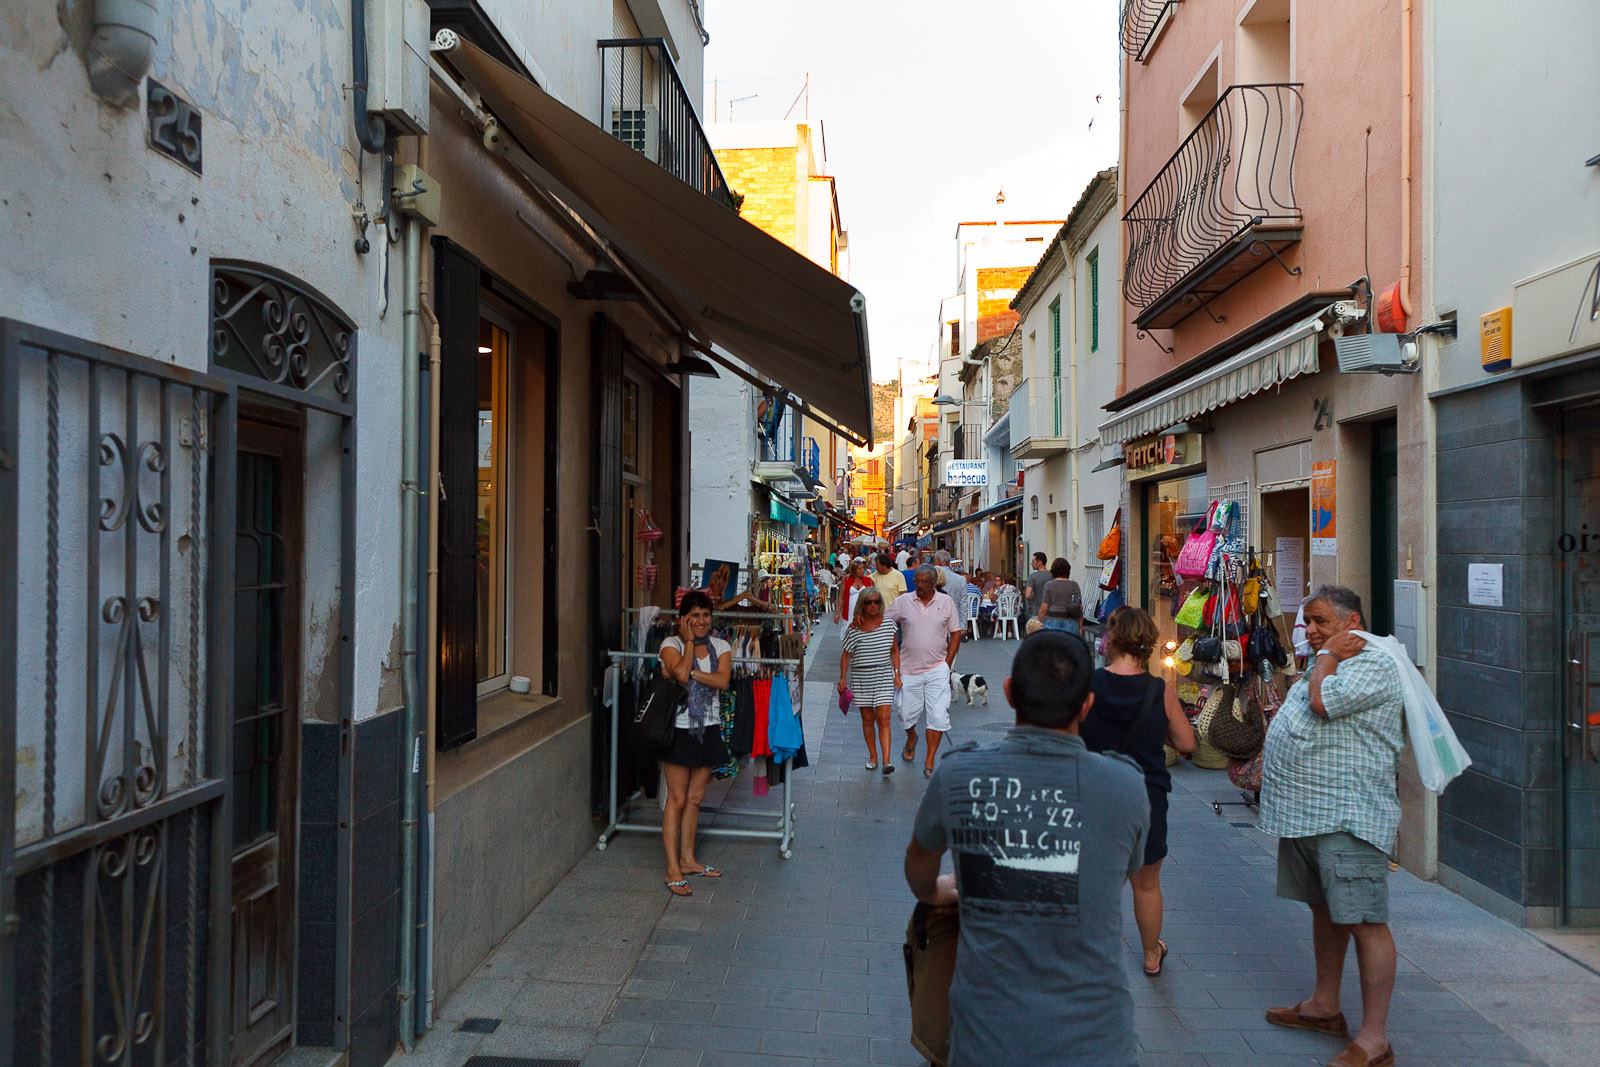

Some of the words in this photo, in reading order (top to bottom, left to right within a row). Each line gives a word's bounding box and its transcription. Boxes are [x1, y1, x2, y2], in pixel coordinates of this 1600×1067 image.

[150, 87, 201, 163] 25
[947, 462, 986, 470] RESTAURANT
[947, 471, 986, 485] barbecue
